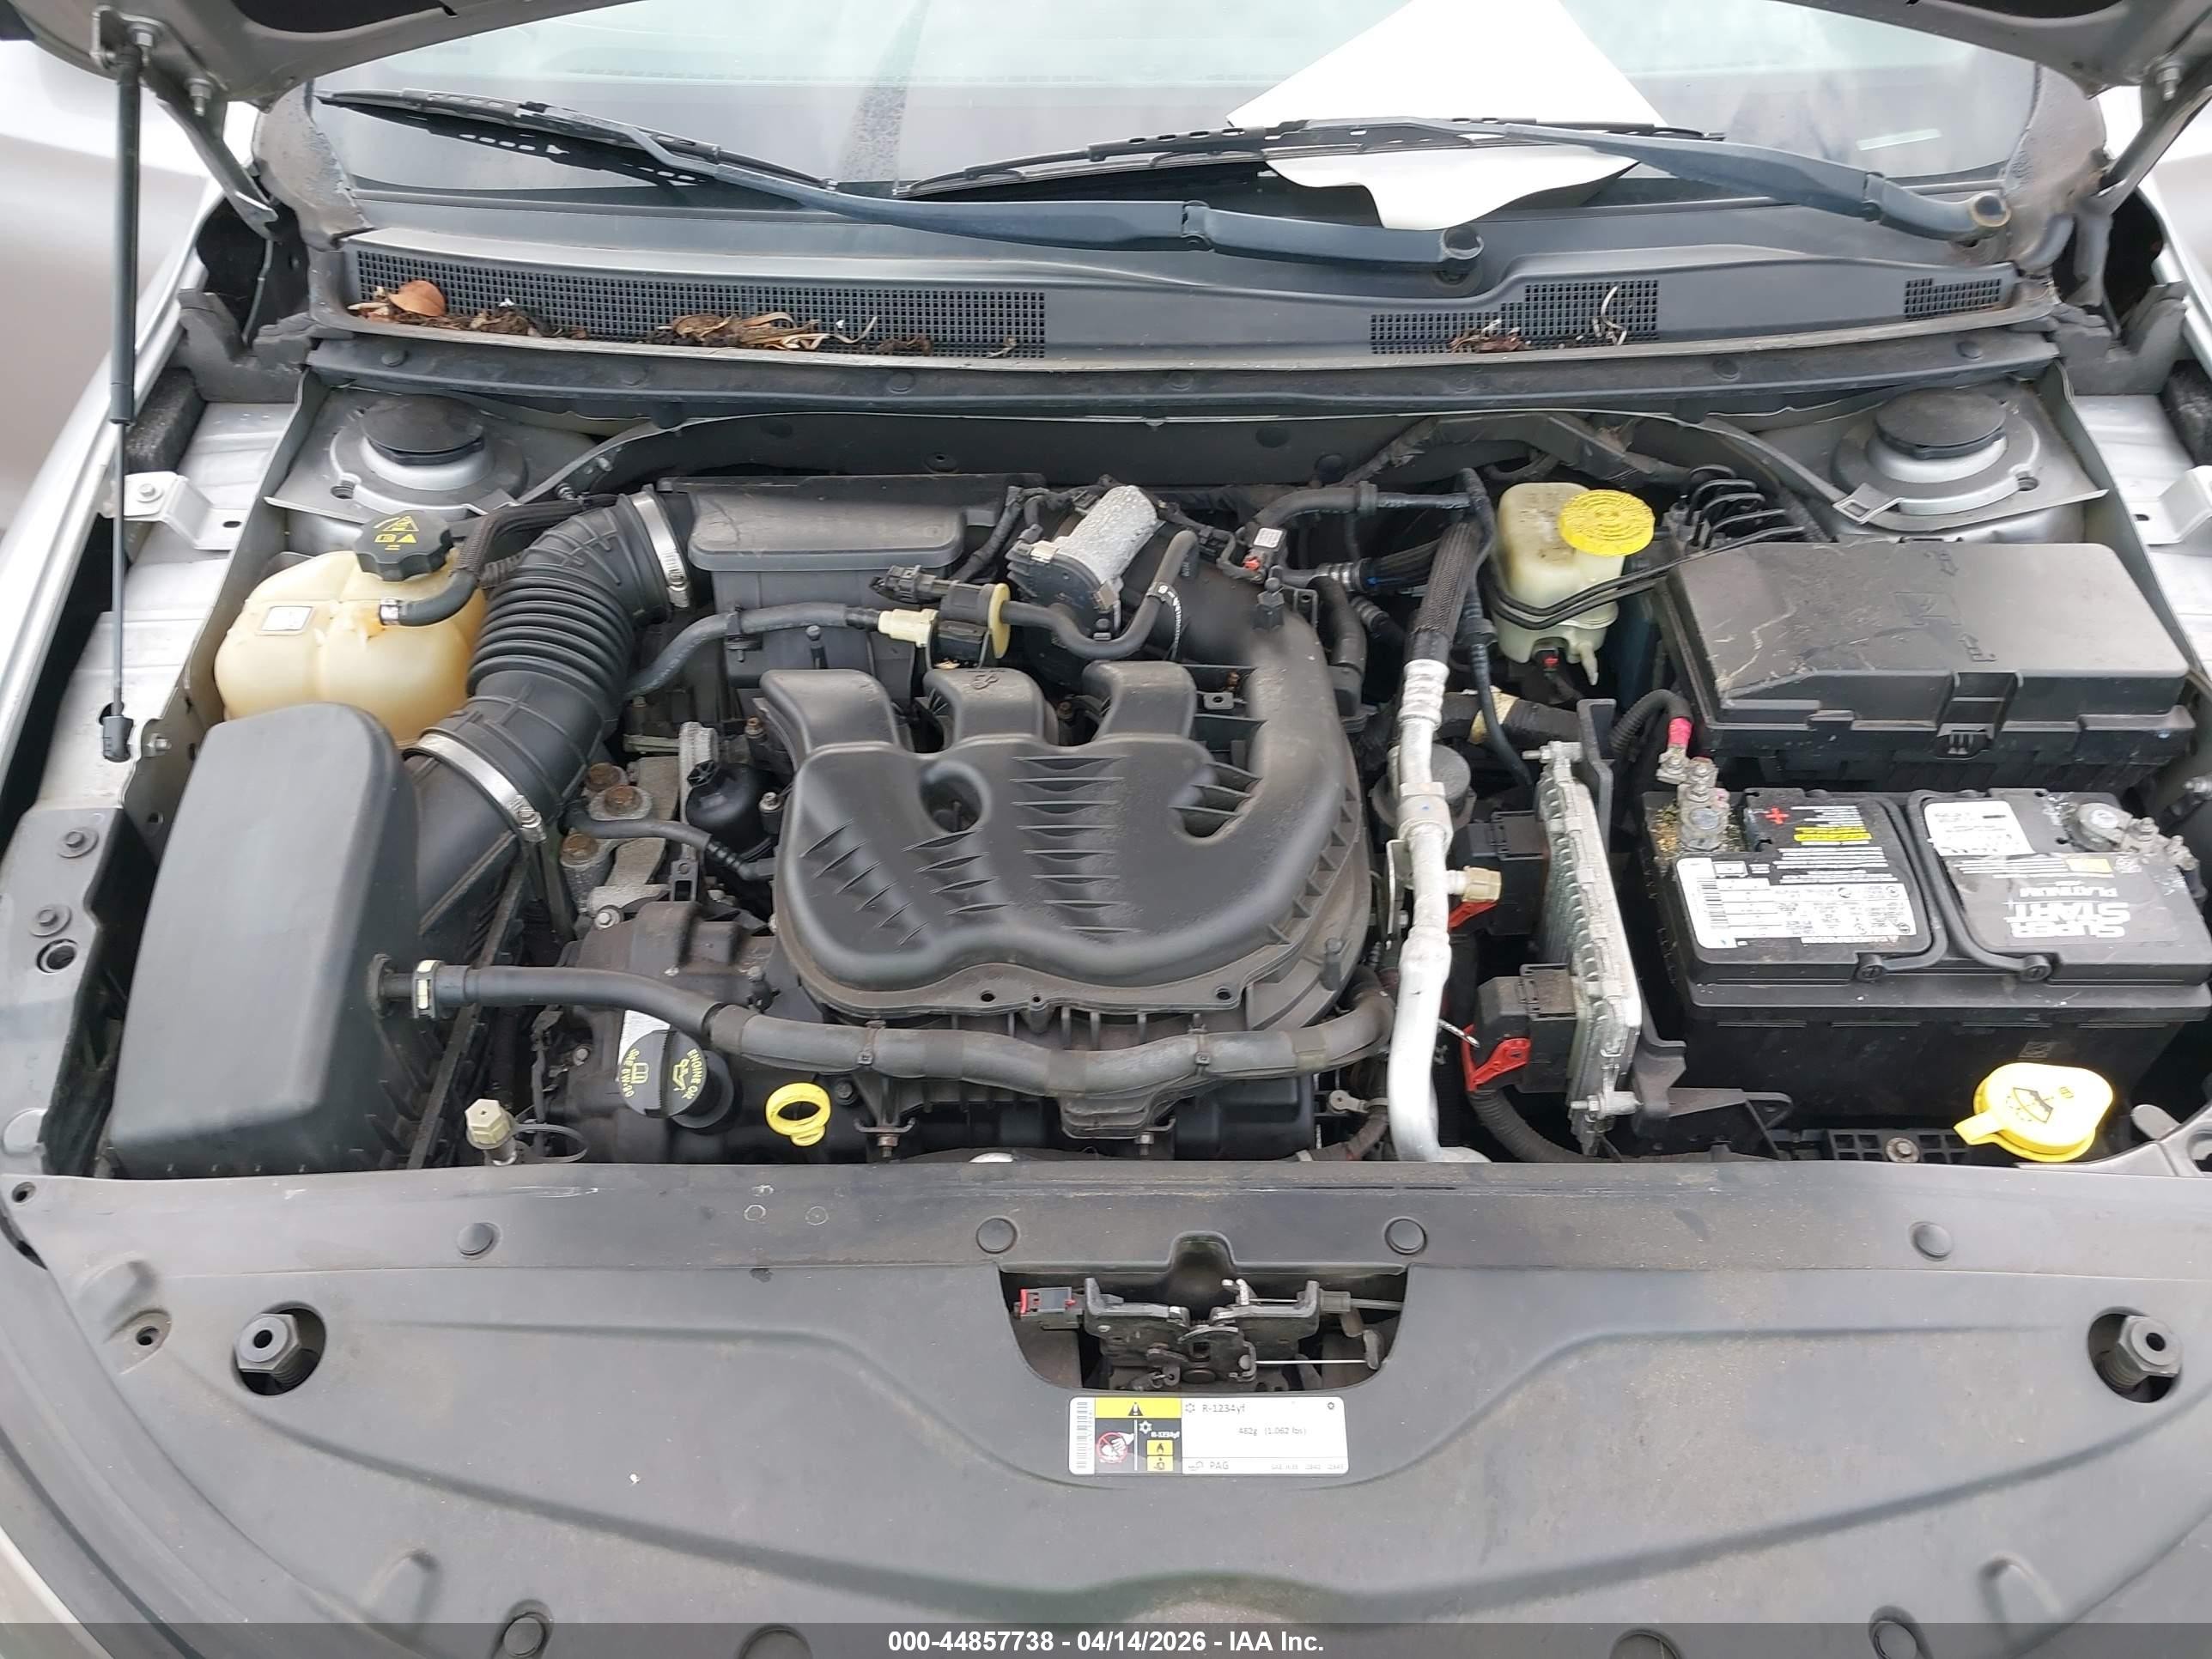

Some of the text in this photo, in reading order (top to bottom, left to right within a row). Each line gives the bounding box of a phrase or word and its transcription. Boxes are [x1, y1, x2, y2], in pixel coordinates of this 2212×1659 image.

[2020, 886, 2118, 897] PLATINUM
[2003, 902, 2130, 925] START
[2010, 920, 2125, 938] SUPER
[687, 1049, 703, 1085] ENGINE
[1202, 1403, 1246, 1415] R-1234yf
[1209, 1461, 1230, 1470] PAG
